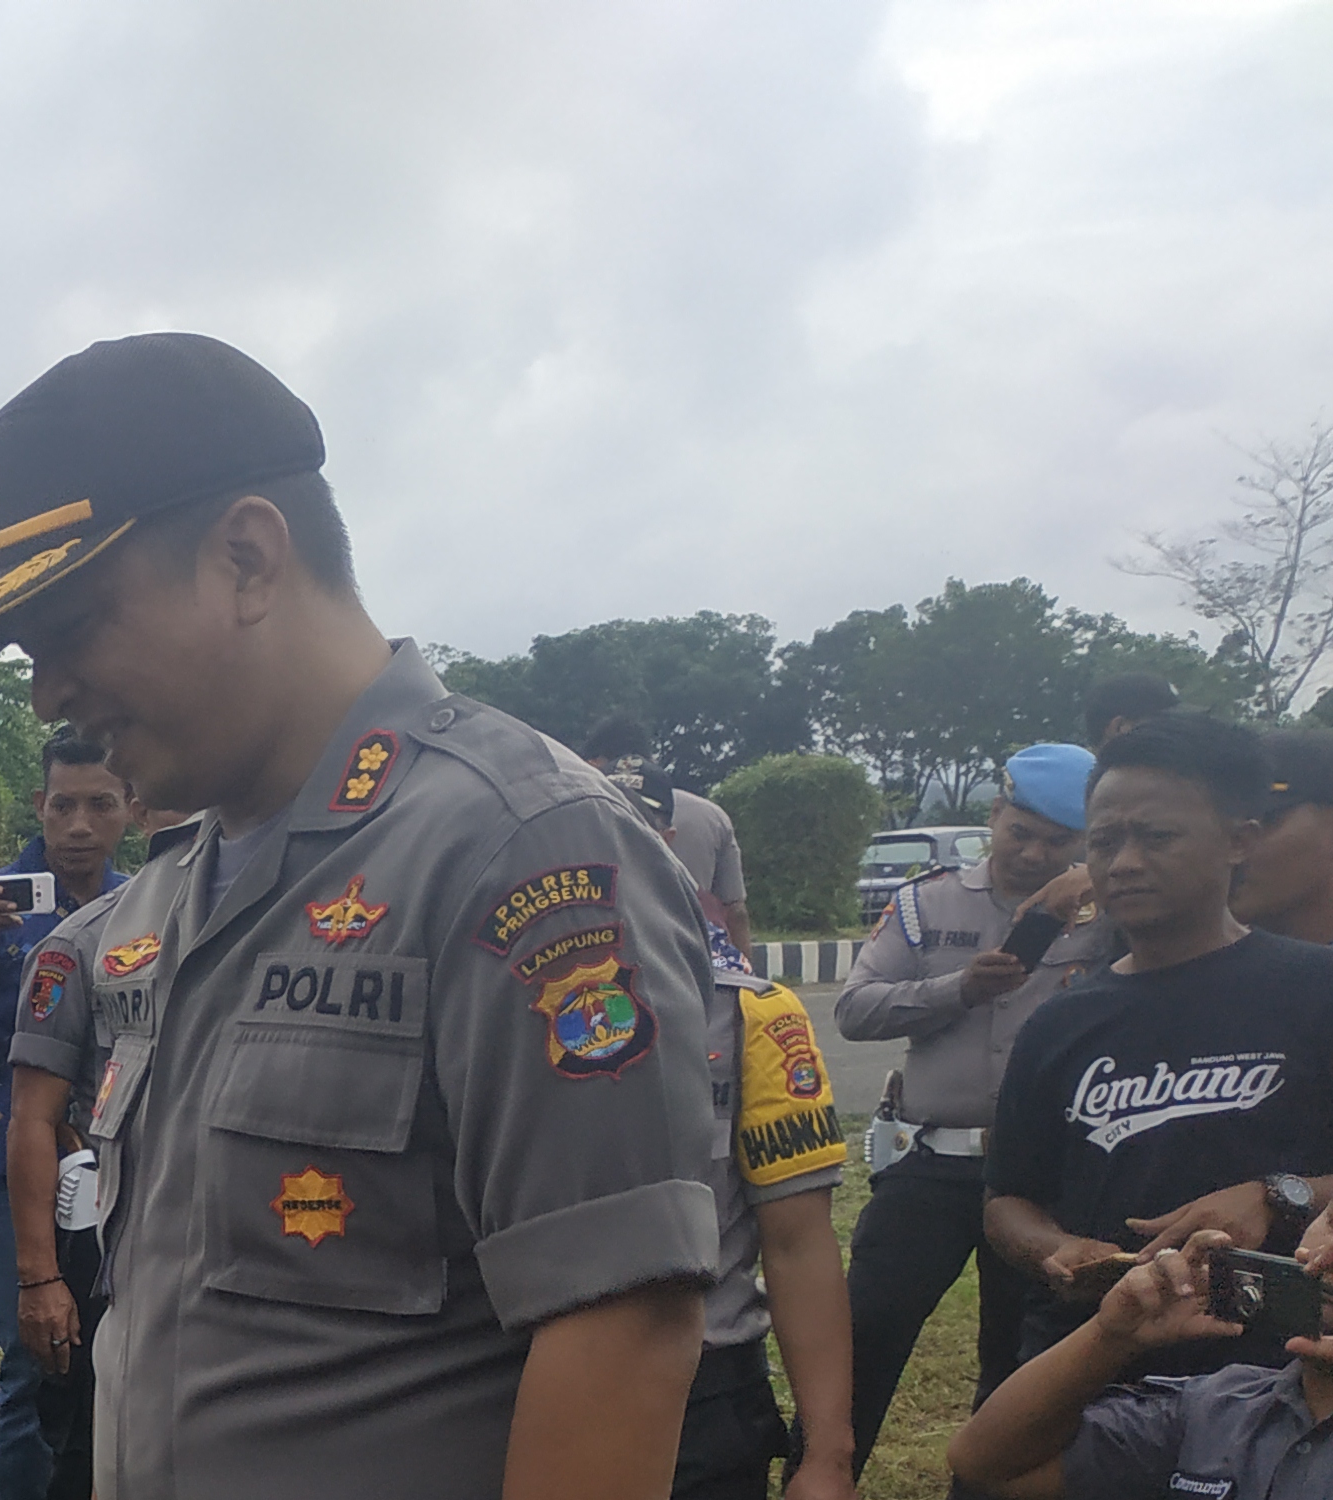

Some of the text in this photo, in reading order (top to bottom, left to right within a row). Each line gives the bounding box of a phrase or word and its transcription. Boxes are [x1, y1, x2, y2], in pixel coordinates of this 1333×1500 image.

[495, 869, 590, 922] POLRES
[497, 885, 602, 942] PRINGSEWU
[521, 930, 615, 976] LAMPUNG
[254, 964, 405, 1023] POLRI
[1190, 1052, 1287, 1065] BANDUNG WEST JAVA
[1065, 1056, 1285, 1128] Lembang
[1104, 1119, 1132, 1144] CITY
